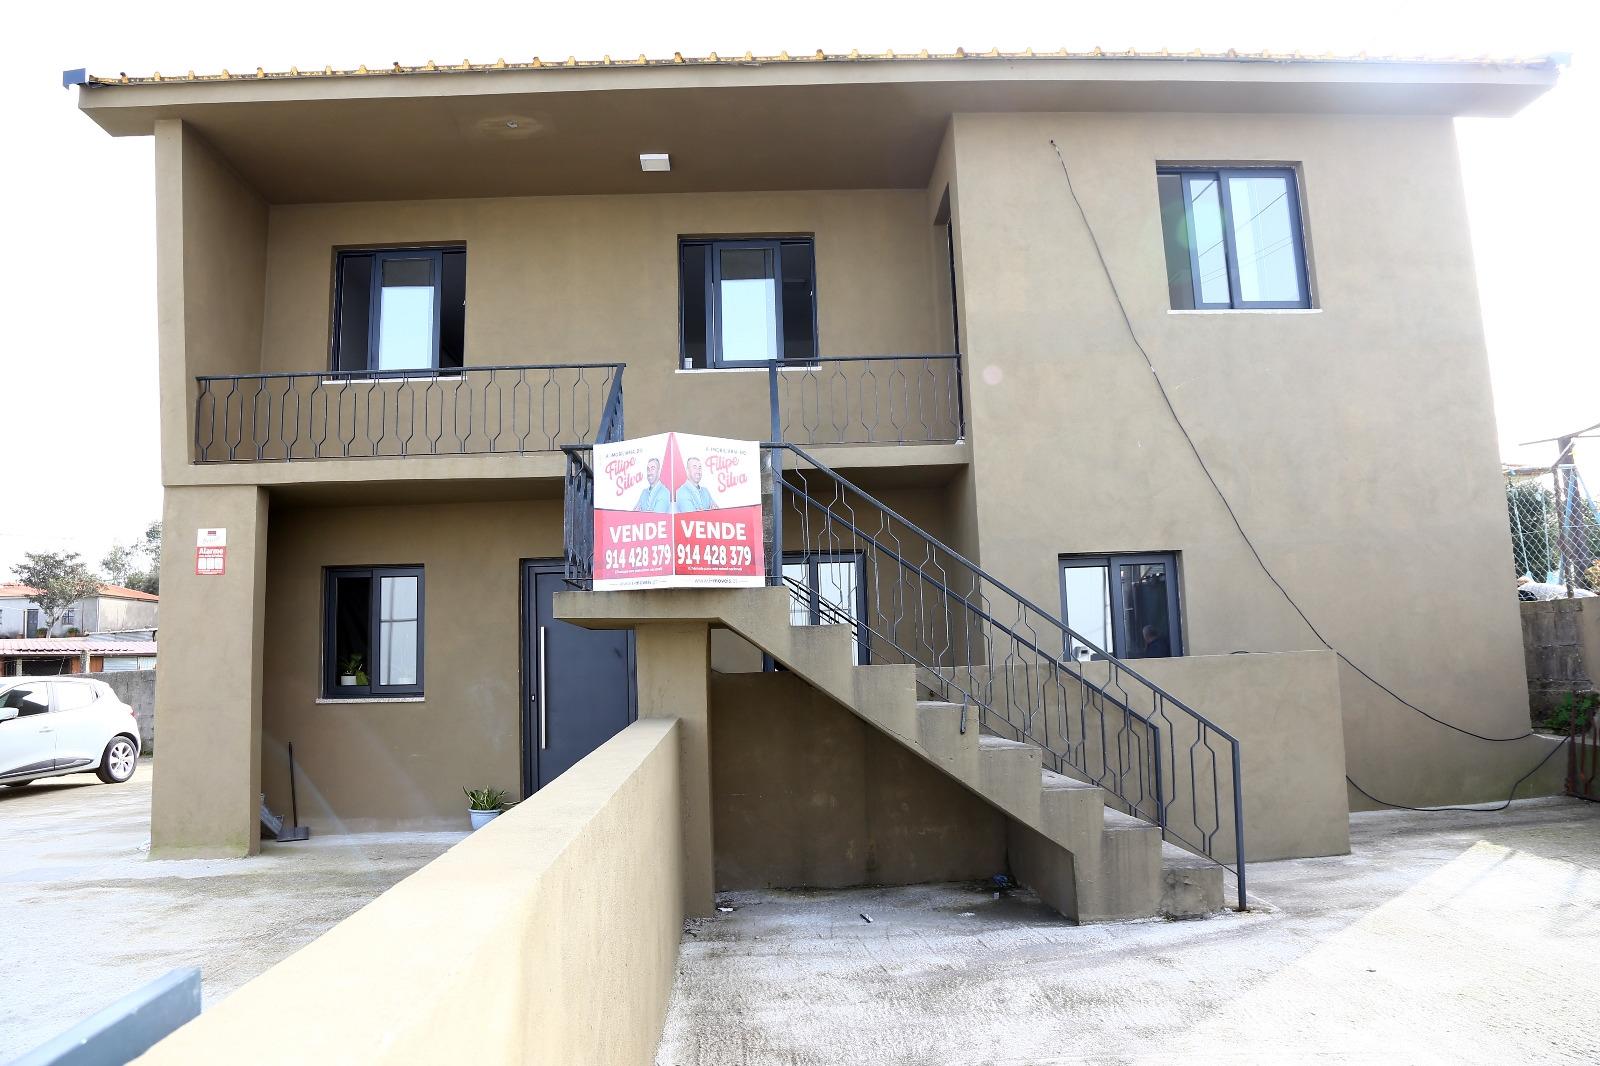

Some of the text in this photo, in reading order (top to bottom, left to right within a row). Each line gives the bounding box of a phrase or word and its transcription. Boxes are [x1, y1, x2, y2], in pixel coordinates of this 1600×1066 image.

[605, 457, 636, 480] Filipe
[705, 455, 739, 475] Filipe
[616, 472, 643, 496] Silva
[717, 472, 747, 493] Silva
[609, 520, 668, 544] VENDE
[680, 520, 747, 540] VENDE
[605, 543, 671, 570] 914 428 379
[677, 543, 752, 566] 914 428 379
